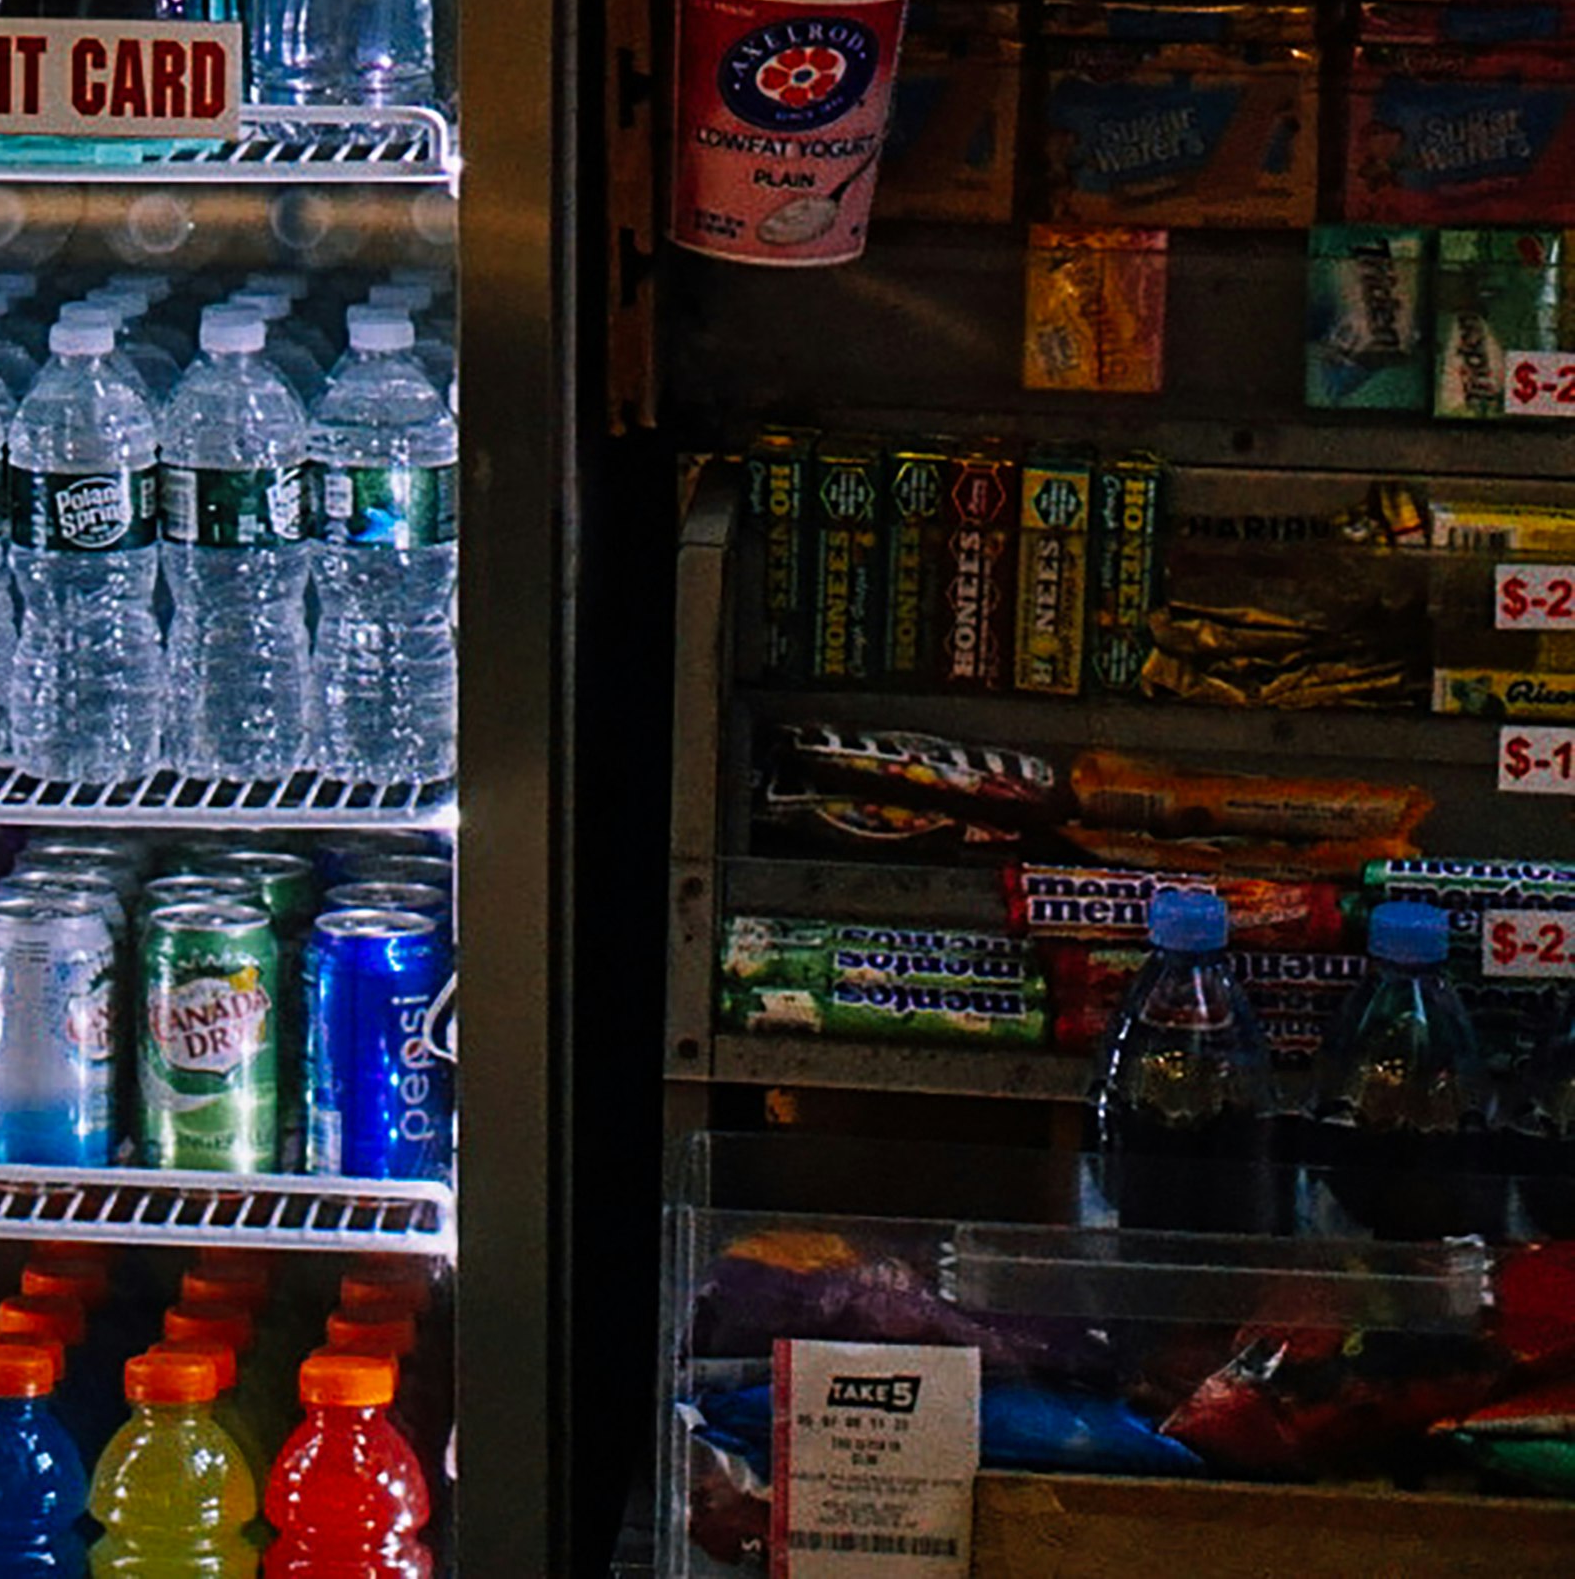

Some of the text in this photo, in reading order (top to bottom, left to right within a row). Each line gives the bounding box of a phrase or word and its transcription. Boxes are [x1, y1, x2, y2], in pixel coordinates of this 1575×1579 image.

[70, 37, 228, 120] CARD
[731, 22, 868, 80] AXELROD
[696, 126, 875, 159] LOWFAT YOGURT
[753, 169, 815, 189] PLAIN
[1118, 478, 1147, 627] HONEES
[825, 528, 851, 676] HONEES
[895, 524, 922, 671] HONEES
[952, 528, 982, 678] HONEES
[835, 949, 1022, 979] mentos
[152, 986, 272, 1044] CANADA
[833, 980, 1023, 1016] mentos
[182, 1020, 248, 1060] DRY
[391, 993, 436, 1142] pepsi
